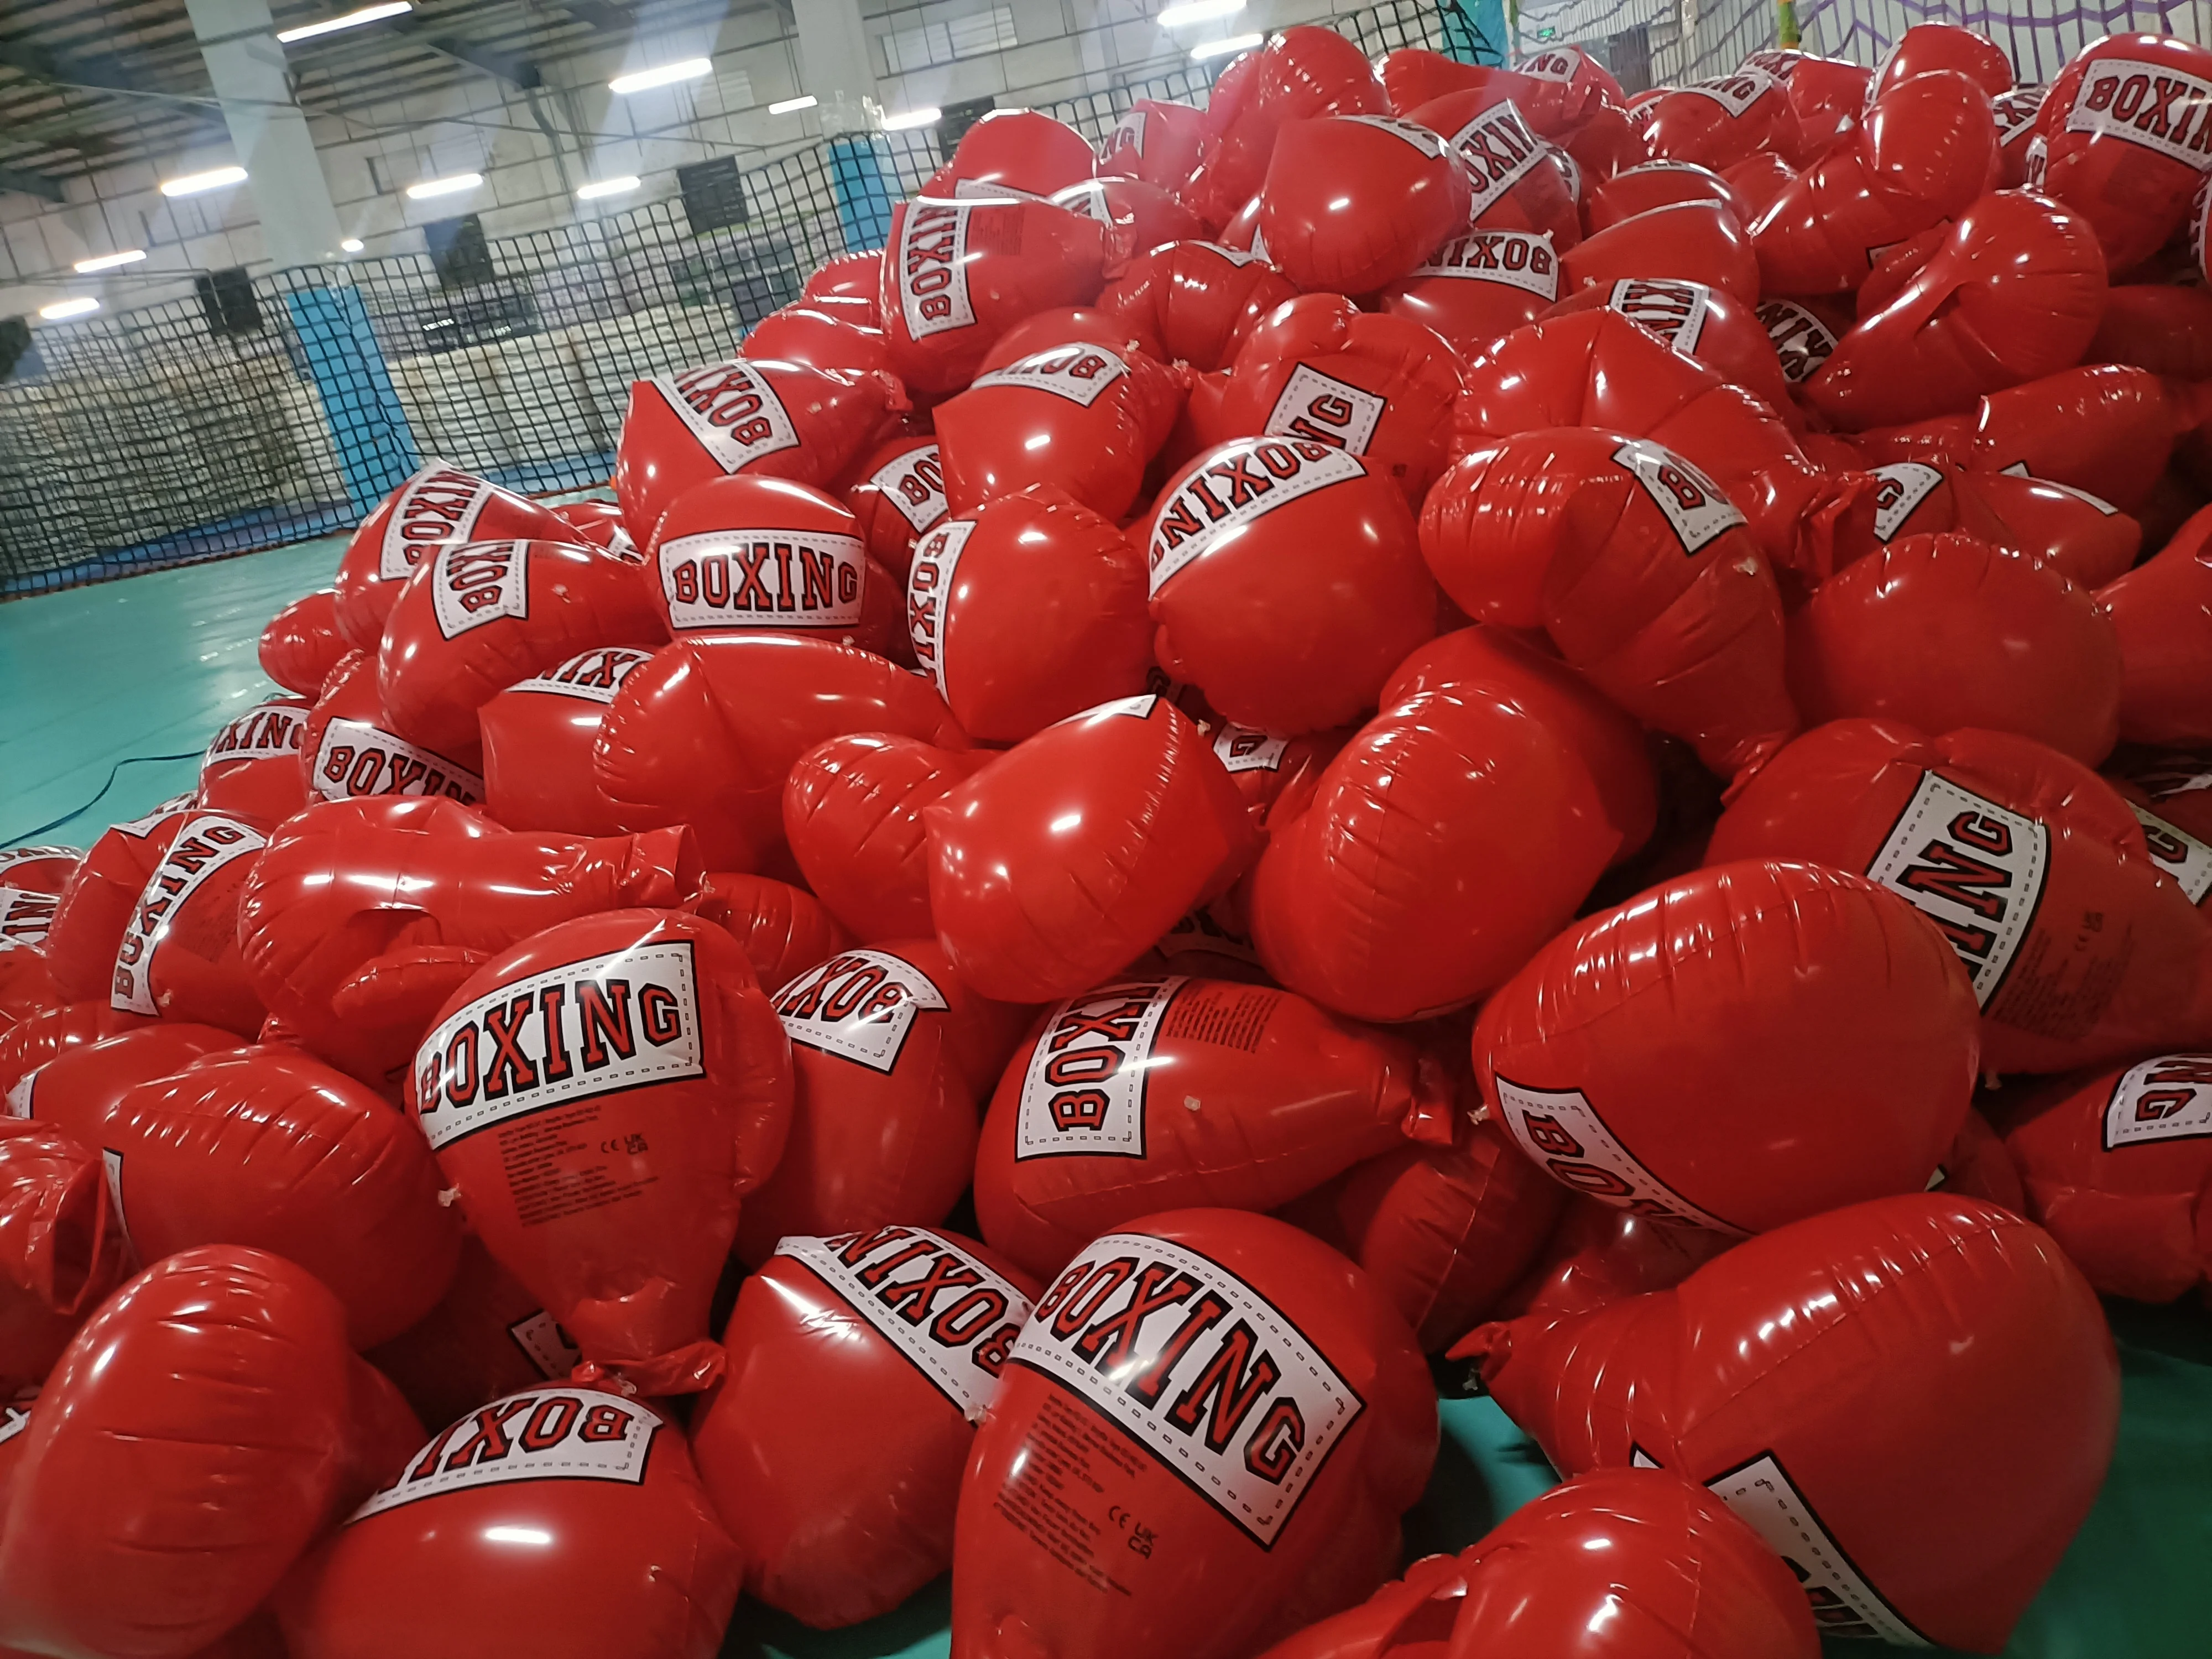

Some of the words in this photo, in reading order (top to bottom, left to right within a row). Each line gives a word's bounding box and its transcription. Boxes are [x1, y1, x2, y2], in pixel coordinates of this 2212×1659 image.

[672, 365, 774, 446] BOXI
[899, 452, 943, 507] BO
[672, 541, 858, 612] BOXING
[115, 826, 246, 999] BOXING
[1895, 810, 2014, 983] ING
[420, 979, 682, 1115] BOXING
[1034, 1256, 1306, 1486] BOXING
